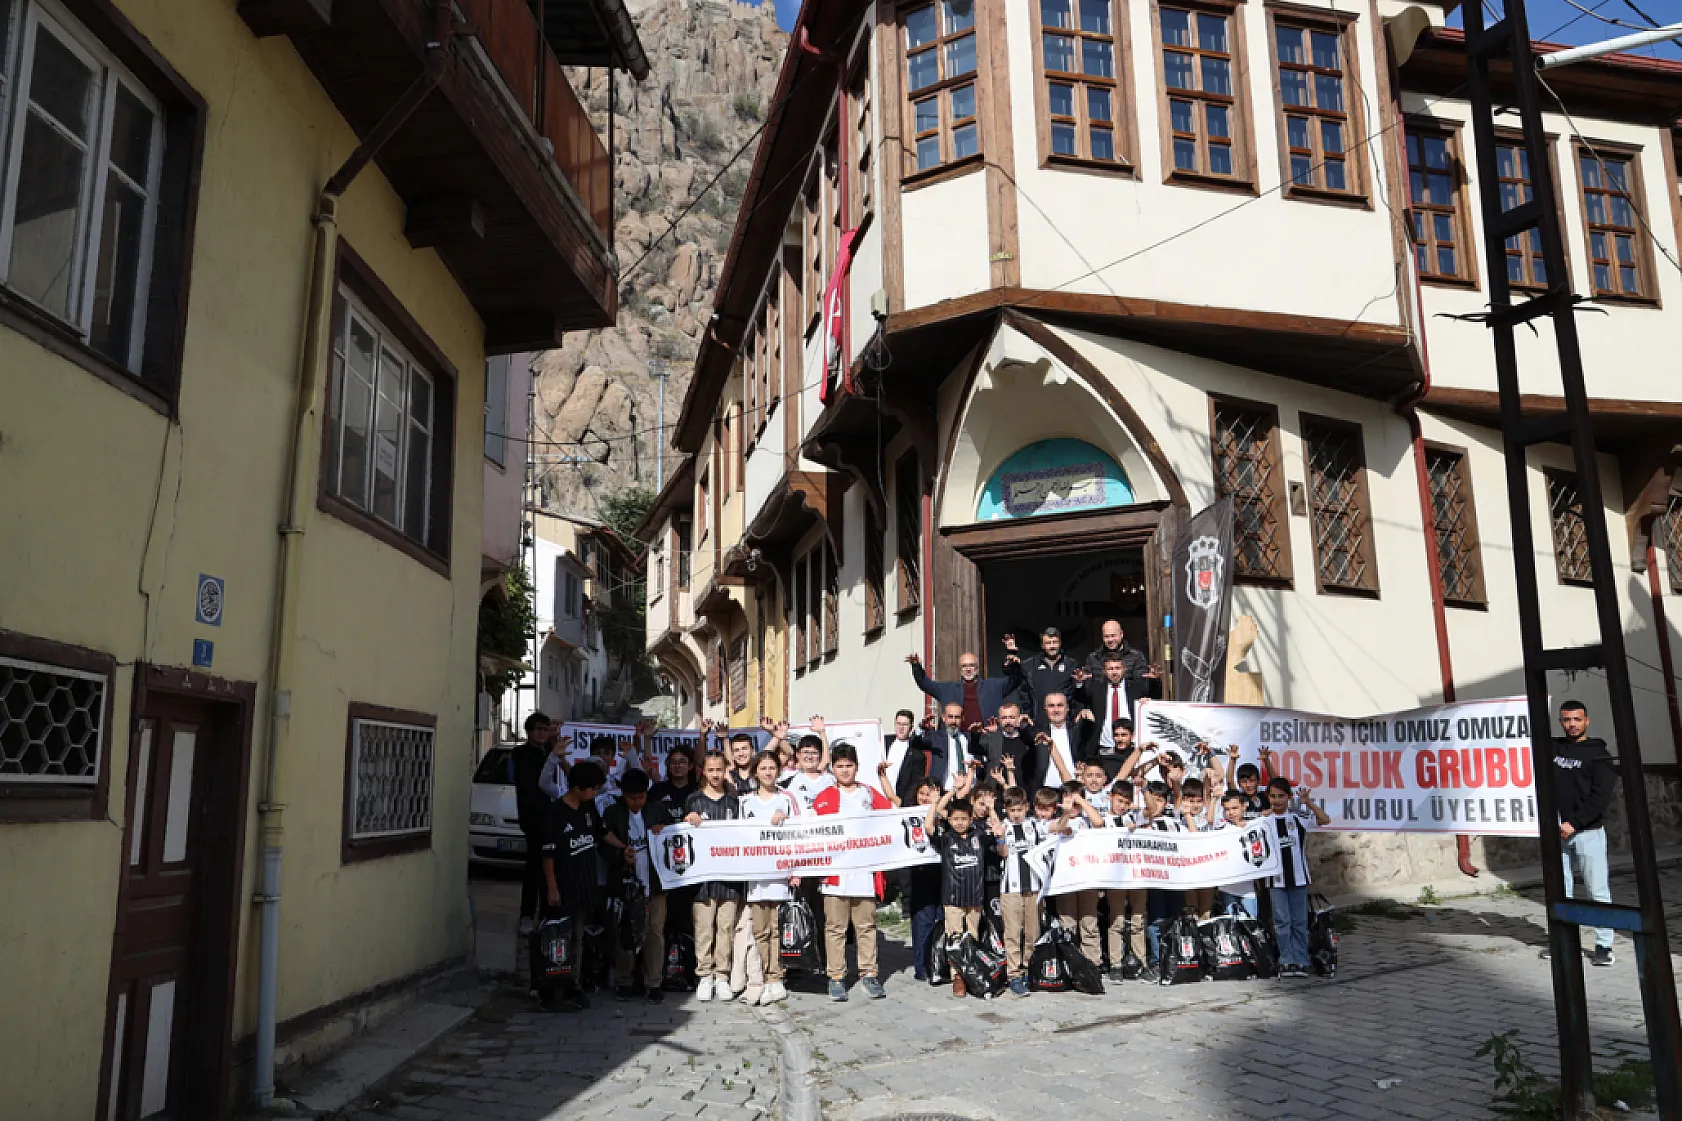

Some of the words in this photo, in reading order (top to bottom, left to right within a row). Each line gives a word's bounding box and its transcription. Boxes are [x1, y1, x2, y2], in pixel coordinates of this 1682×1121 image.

[1260, 718, 1344, 746] BEŞİKTAŞ
[1351, 718, 1387, 746] İÇİN
[1395, 718, 1450, 743] OMUZ
[1457, 715, 1532, 740] OMUZA
[1415, 746, 1532, 789] GRUBU
[1343, 798, 1418, 821] KURUL
[1431, 795, 1535, 823] ÜYELERİ
